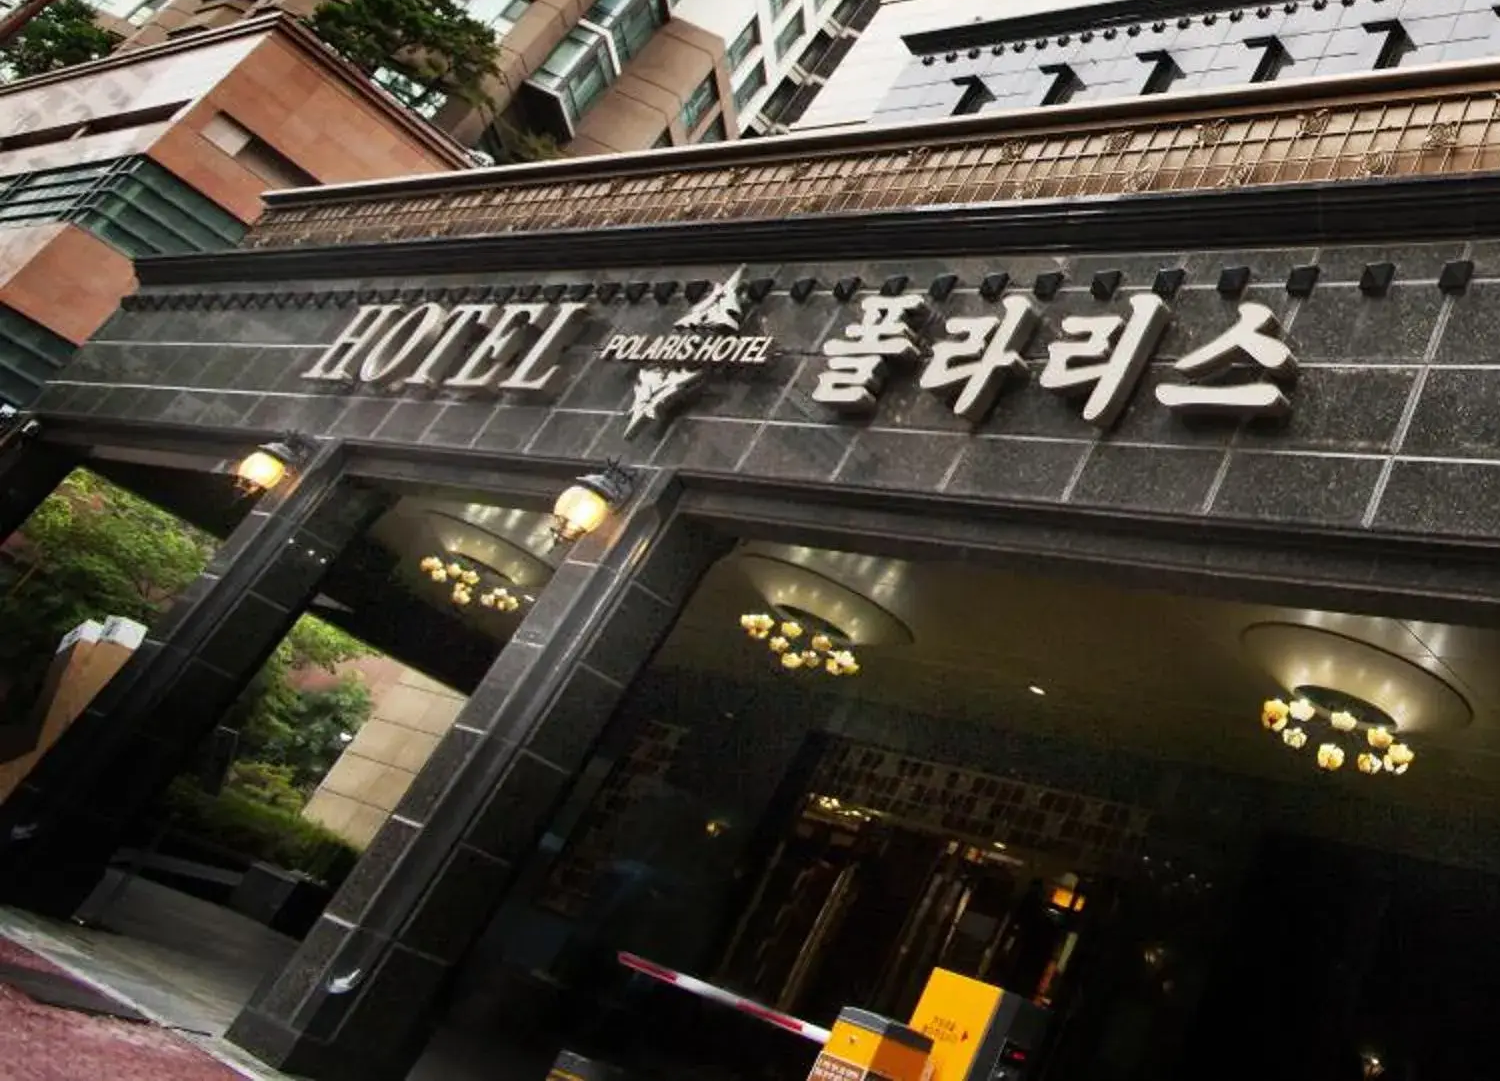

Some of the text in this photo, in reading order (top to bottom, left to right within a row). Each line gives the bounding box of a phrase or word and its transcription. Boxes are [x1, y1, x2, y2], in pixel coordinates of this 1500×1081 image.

[301, 301, 588, 391] HOTEL
[600, 334, 774, 363] POLARIS HOTEL
[811, 292, 1299, 420] 폴라리스
